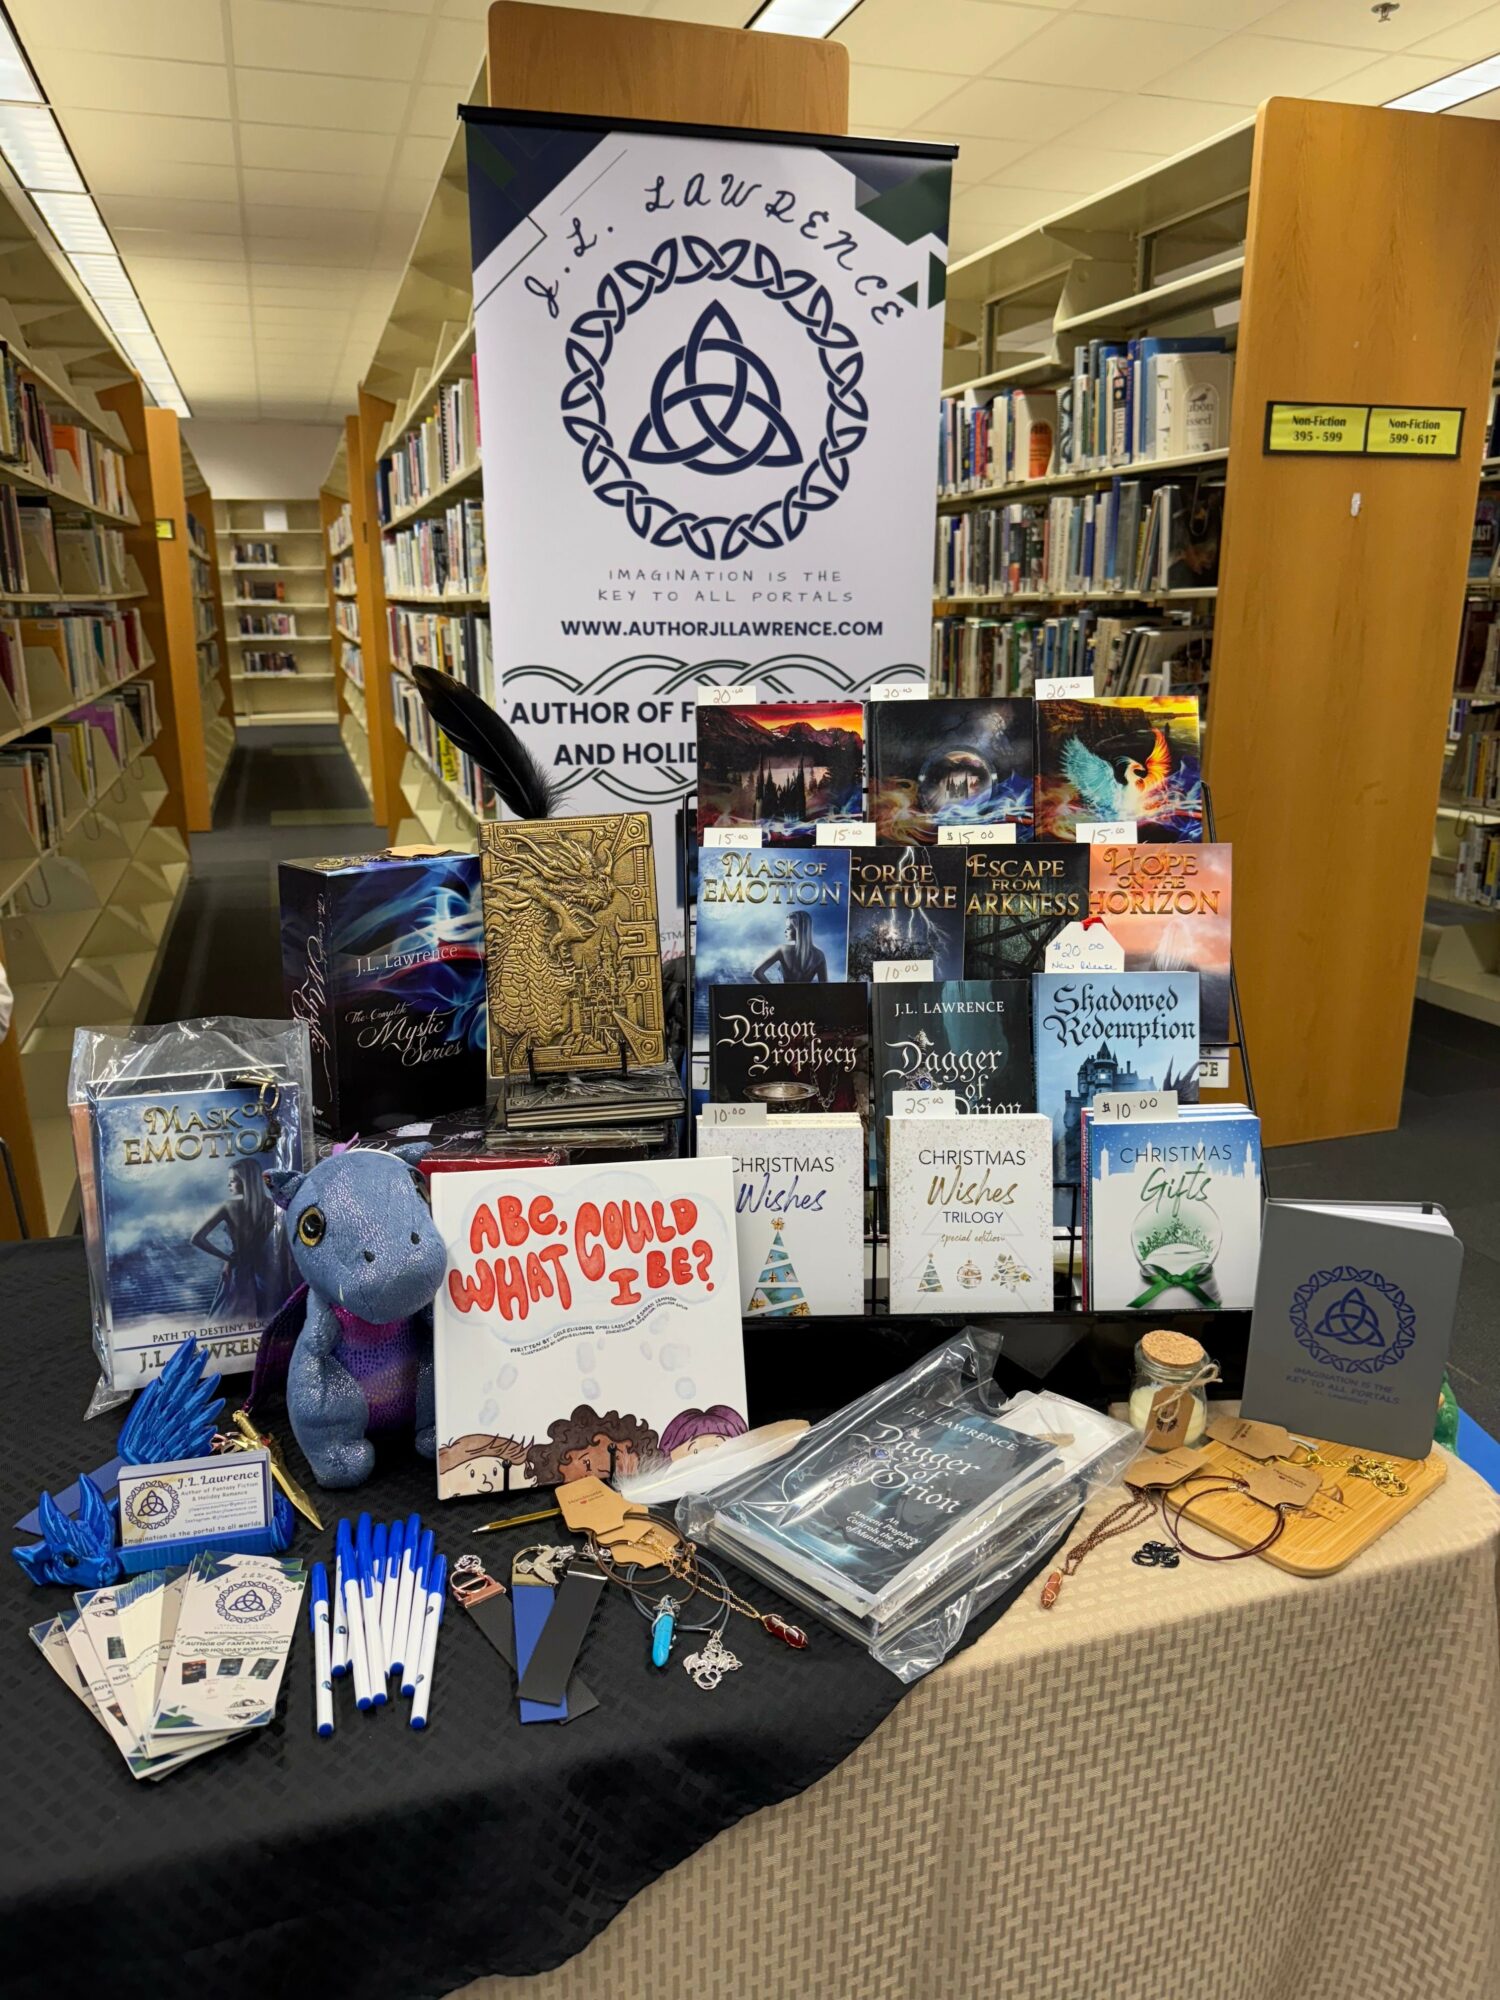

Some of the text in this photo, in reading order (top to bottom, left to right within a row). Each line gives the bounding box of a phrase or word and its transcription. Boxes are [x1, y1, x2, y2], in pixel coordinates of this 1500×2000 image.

[525, 173, 905, 325] J.L. LAWRENCE
[1291, 415, 1347, 427] Non-Fiction
[1388, 418, 1441, 430] Non-Fiction
[1293, 431, 1313, 442] 395
[1322, 431, 1343, 443] 599
[1389, 433, 1409, 444] 599
[1417, 434, 1437, 445] 617
[609, 569, 842, 582] IMAGINATION IS THE
[598, 589, 854, 603] KEY TO ALL PORTALS
[560, 620, 884, 637] WWW.AUTHORJLLAWRENCE.COM
[509, 701, 630, 725] AUTHOR
[637, 701, 674, 724] OF
[553, 742, 697, 766] AND HOLI
[721, 851, 828, 878] MASK OF
[851, 856, 935, 883] FORCE
[965, 853, 1065, 878] ESCAPE
[1103, 847, 1199, 877] HOPE
[703, 878, 843, 905] EMOTION
[991, 879, 1041, 892] FROM
[1117, 876, 1186, 889] ON THE
[851, 884, 958, 909] NATURE
[966, 892, 1081, 916] ARKNESS
[1089, 890, 1221, 915] HORIZON
[356, 945, 458, 978] J.L. Lawrence
[747, 994, 775, 1018] The
[893, 1001, 1005, 1018] J.L. LAWRENCE
[1053, 982, 1179, 1019] Shadowed
[344, 1009, 366, 1025] The
[357, 1006, 458, 1051] Mystic
[716, 1012, 816, 1048] Dragon
[1042, 1012, 1196, 1049] Redemption
[401, 1036, 463, 1067] Series
[743, 1038, 857, 1078] Prophecy
[883, 1040, 1004, 1082] Dagger
[965, 1075, 988, 1100] of
[142, 1103, 243, 1136] MASK
[122, 1129, 264, 1166] EMOTIO
[918, 1149, 1026, 1166] CHRISTMAS
[1120, 1144, 1232, 1164] CHRISTMAS
[731, 1156, 835, 1173] CHRISTMAS
[735, 1171, 827, 1214] Wishes
[926, 1164, 1018, 1206] Wishes
[1140, 1162, 1212, 1218] Gifts
[942, 1211, 1004, 1224] TRILOGY
[469, 1194, 698, 1282] ABC, COULD
[940, 1230, 1006, 1247] special edition
[448, 1238, 714, 1321] WHAT I BE?
[152, 1331, 179, 1342] PATH
[182, 1329, 196, 1339] TO
[510, 1340, 542, 1354] WRITTEN
[1285, 1374, 1306, 1384] KEY
[1311, 1379, 1324, 1388] TO
[1328, 1383, 1345, 1393] ALL
[1351, 1388, 1401, 1405] PORTALS
[1293, 1366, 1393, 1393] IMAGINATION IS THE
[902, 1406, 1020, 1452] J.L. LAWRENCE
[847, 1419, 982, 1476] Dagger
[177, 1471, 260, 1490] J.L. Lawrence
[203, 1486, 210, 1494] of
[212, 1485, 236, 1493] Fantasy
[237, 1481, 259, 1489] Fiction
[870, 1463, 961, 1514] Orion
[910, 1469, 949, 1485] of
[198, 1494, 221, 1502] Holiday
[222, 1490, 248, 1498] Romance
[124, 1533, 168, 1545] Imagination
[193, 1526, 215, 1538] portal
[238, 1520, 262, 1529] worlds
[845, 1525, 859, 1533] of
[846, 1516, 913, 1550] Controls the Fate
[850, 1510, 921, 1546] Ancient Prophecy
[885, 1516, 900, 1526] An
[226, 1639, 259, 1647] FANTASY
